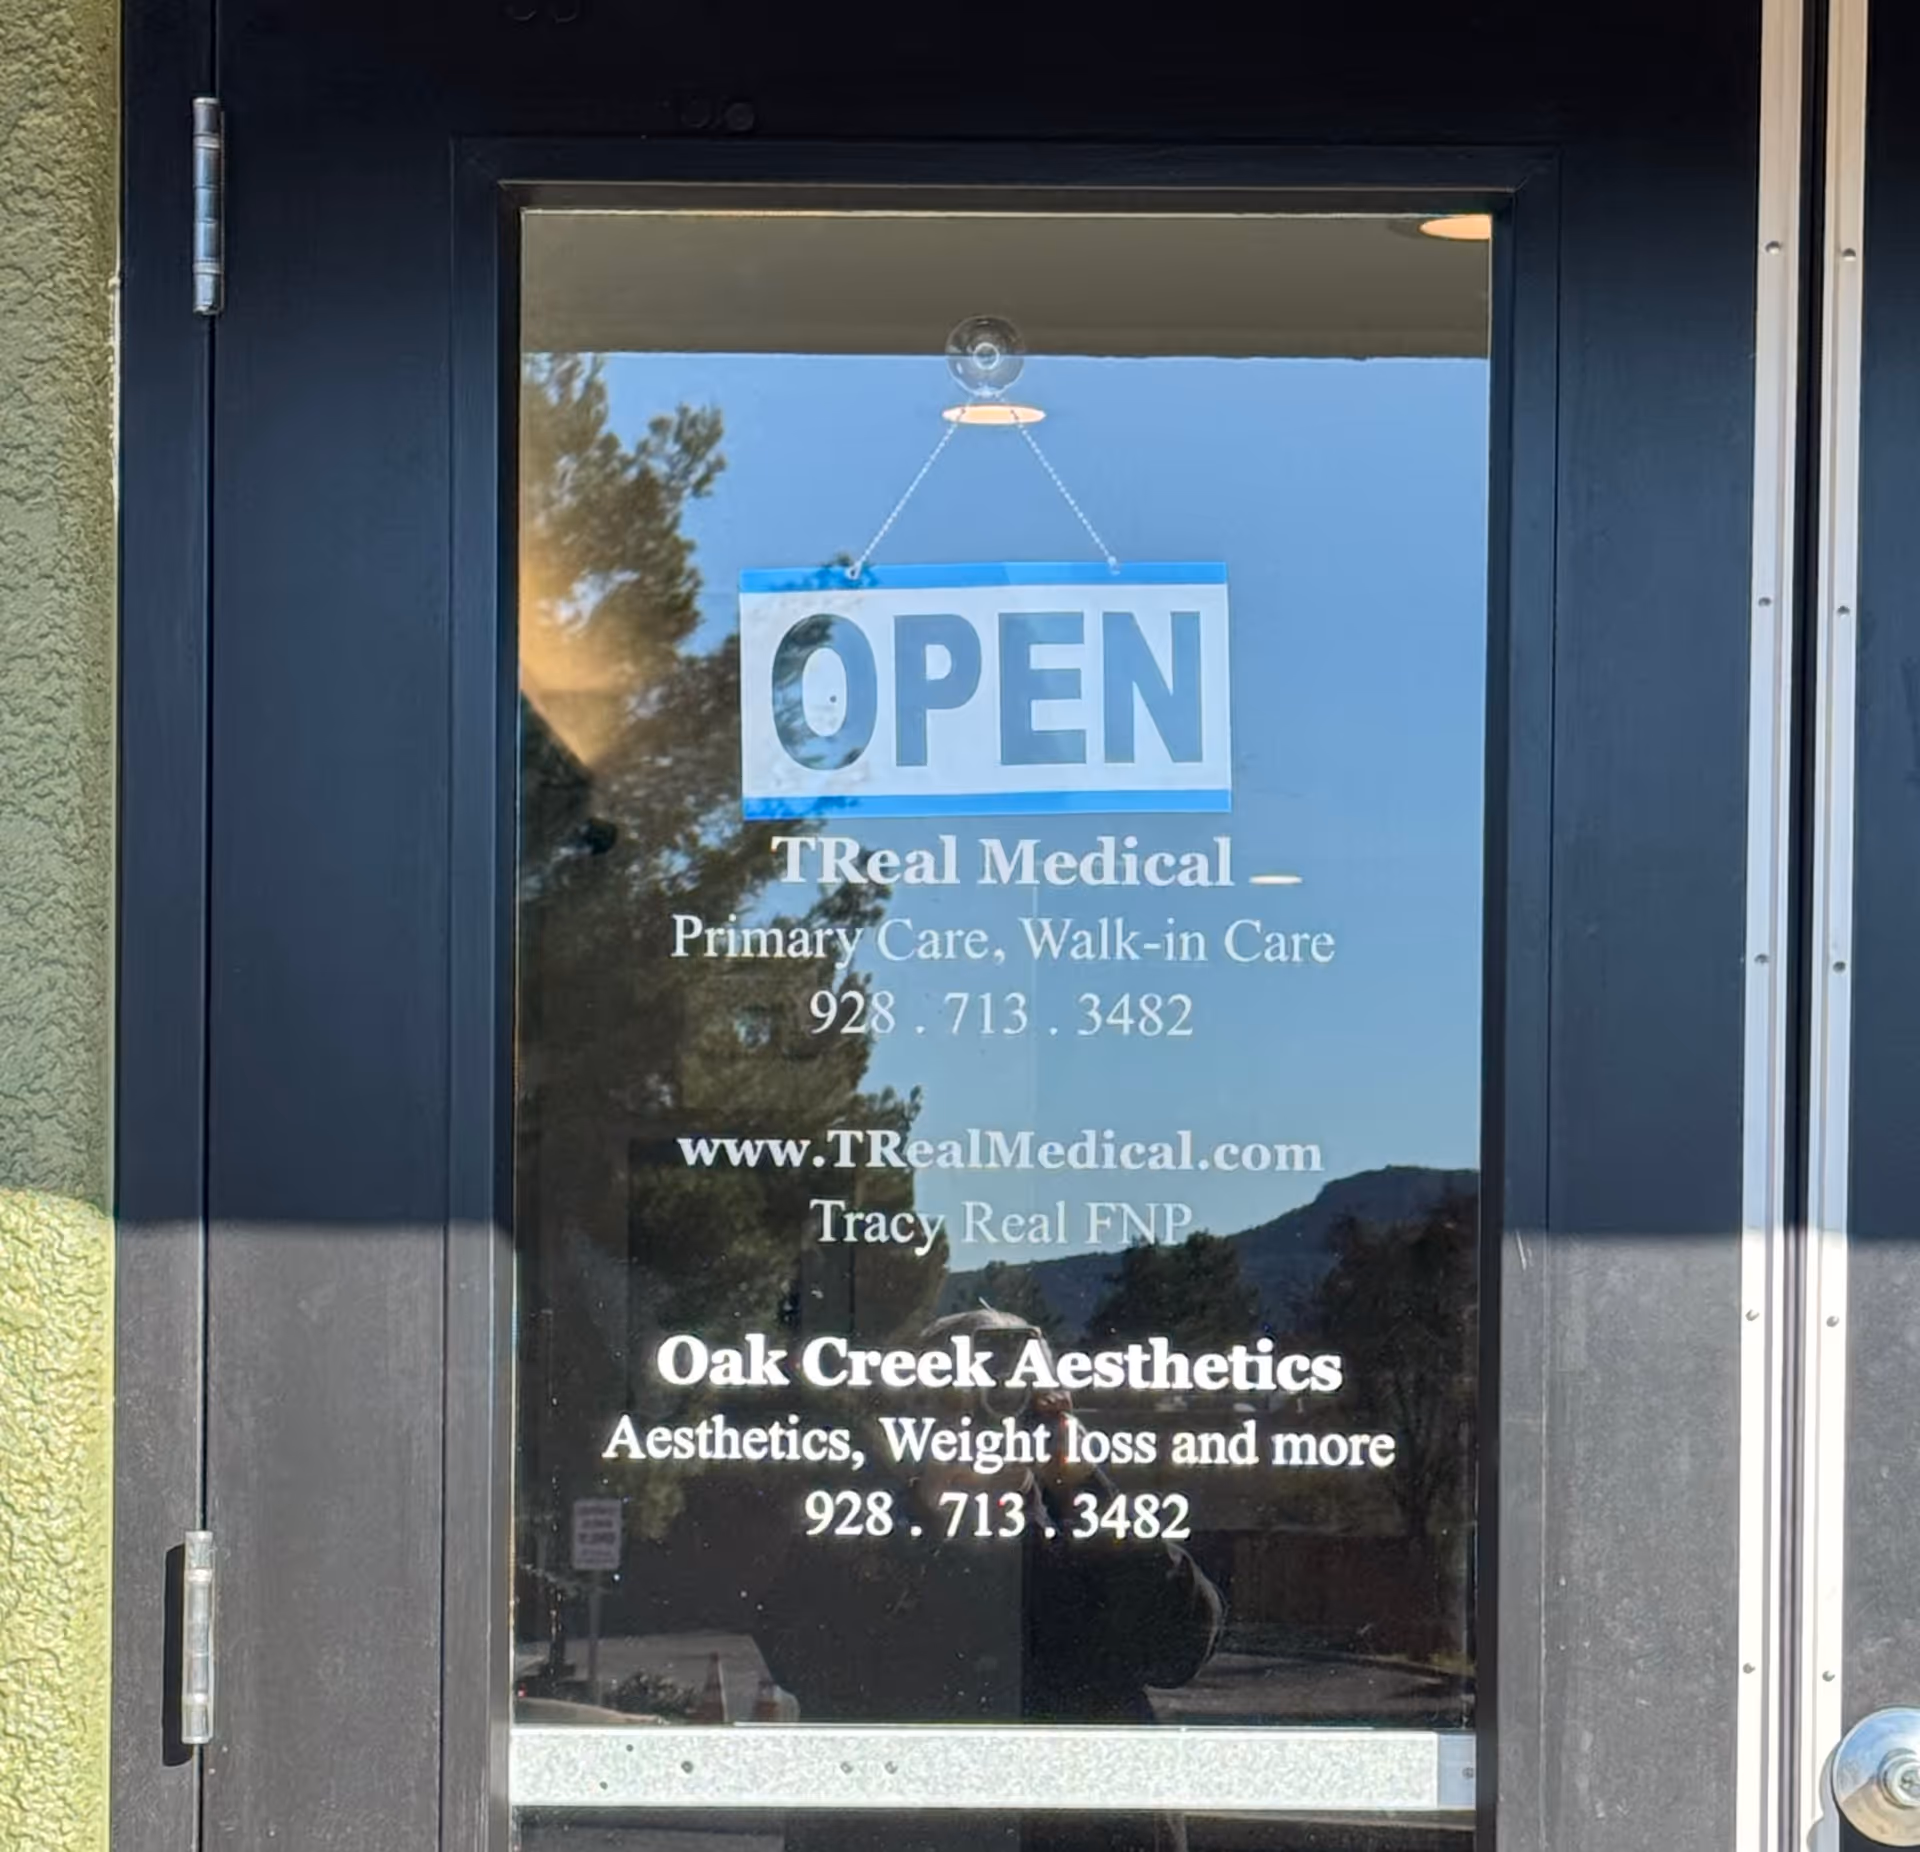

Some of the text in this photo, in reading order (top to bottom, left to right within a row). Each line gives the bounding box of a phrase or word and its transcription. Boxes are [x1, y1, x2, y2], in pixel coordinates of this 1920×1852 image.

[771, 611, 1202, 771] OPEN
[770, 835, 1235, 889] TReal Medical
[671, 914, 1336, 967] Primary Care, Walk-in Care
[809, 990, 895, 1036] 928
[945, 992, 1028, 1036] 713
[1077, 993, 1194, 1038] 3482
[677, 1128, 1324, 1172] www.TRealMedical.com
[810, 1198, 1193, 1256] Tracy Real FNP
[657, 1334, 1344, 1392] Oak Creek Aesthetics
[603, 1415, 1396, 1472] Aesthetics, Weight loss and more
[804, 1491, 893, 1536] 928
[939, 1492, 1025, 1538] 713
[1072, 1493, 1191, 1541] 3482
